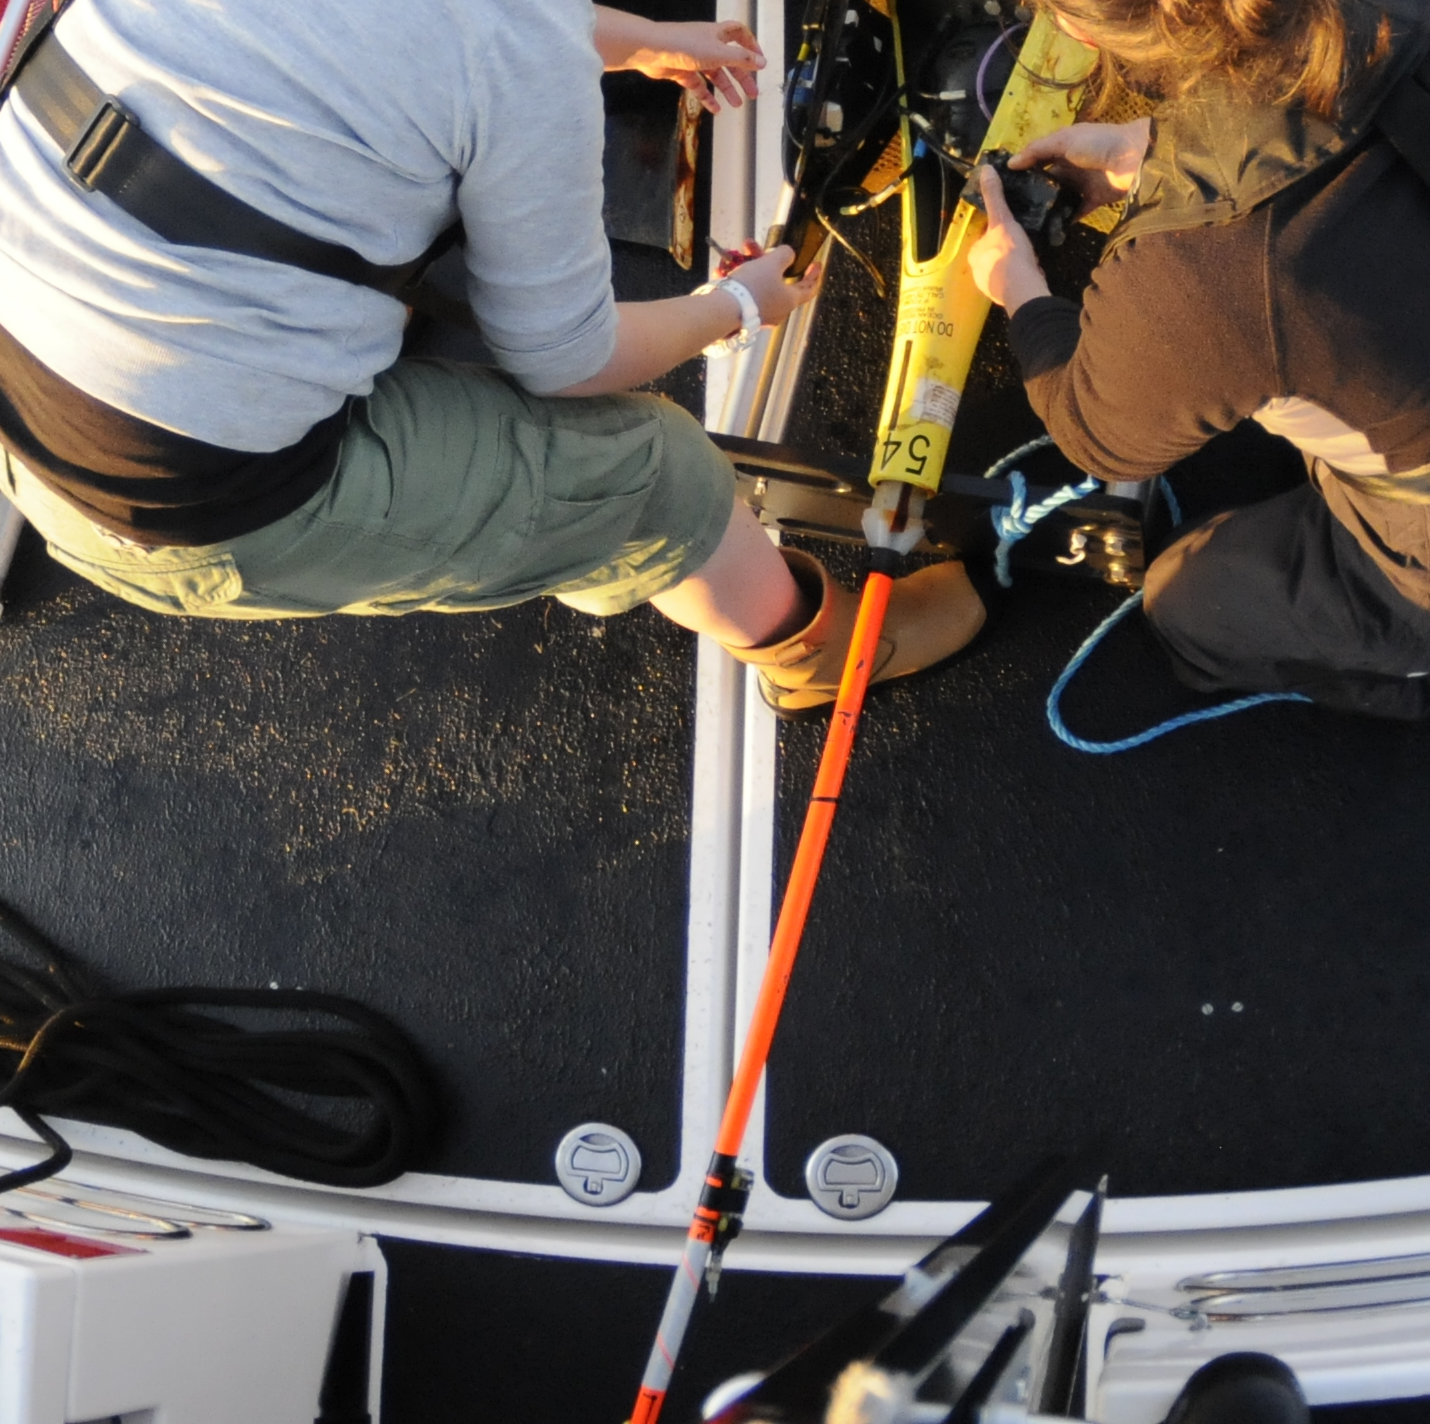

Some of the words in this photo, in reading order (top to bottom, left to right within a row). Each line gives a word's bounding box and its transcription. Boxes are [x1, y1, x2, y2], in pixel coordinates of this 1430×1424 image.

[912, 320, 935, 334] NOT
[936, 321, 954, 337] DO
[880, 434, 931, 476] 54
